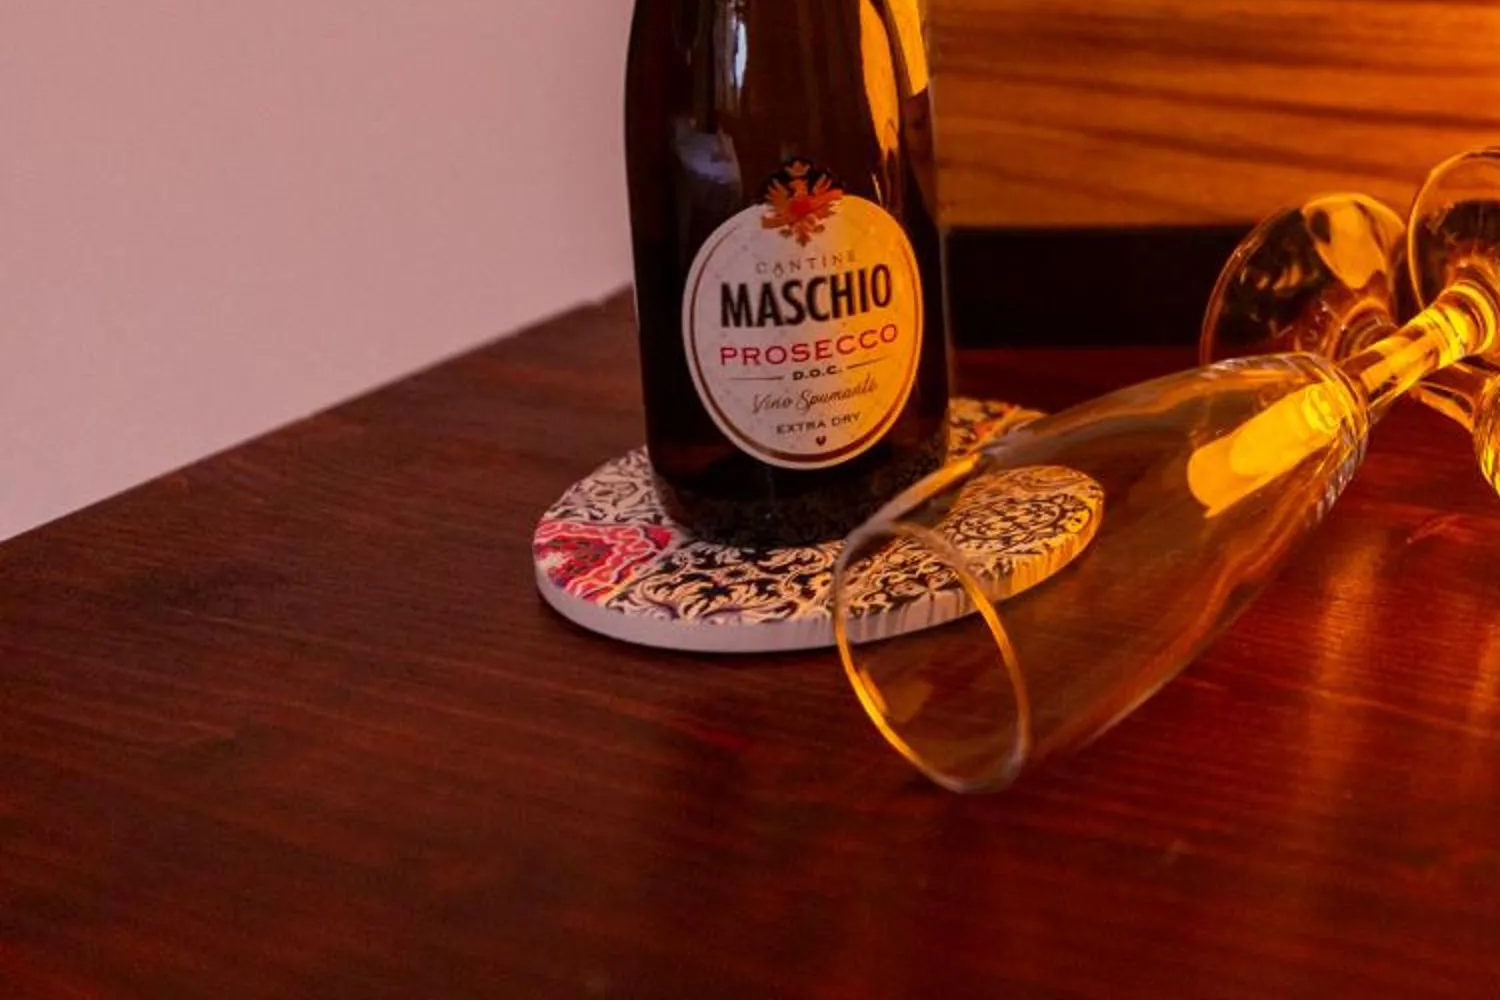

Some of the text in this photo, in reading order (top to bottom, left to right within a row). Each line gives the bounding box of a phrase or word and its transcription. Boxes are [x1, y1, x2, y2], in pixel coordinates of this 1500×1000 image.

[756, 252, 856, 277] CANTINE
[720, 264, 892, 328] MASCHIO
[720, 323, 897, 366] PROSECCO
[792, 365, 841, 381] D.O.C.
[752, 392, 791, 415] Vino
[776, 411, 861, 434] EXTRA DRY
